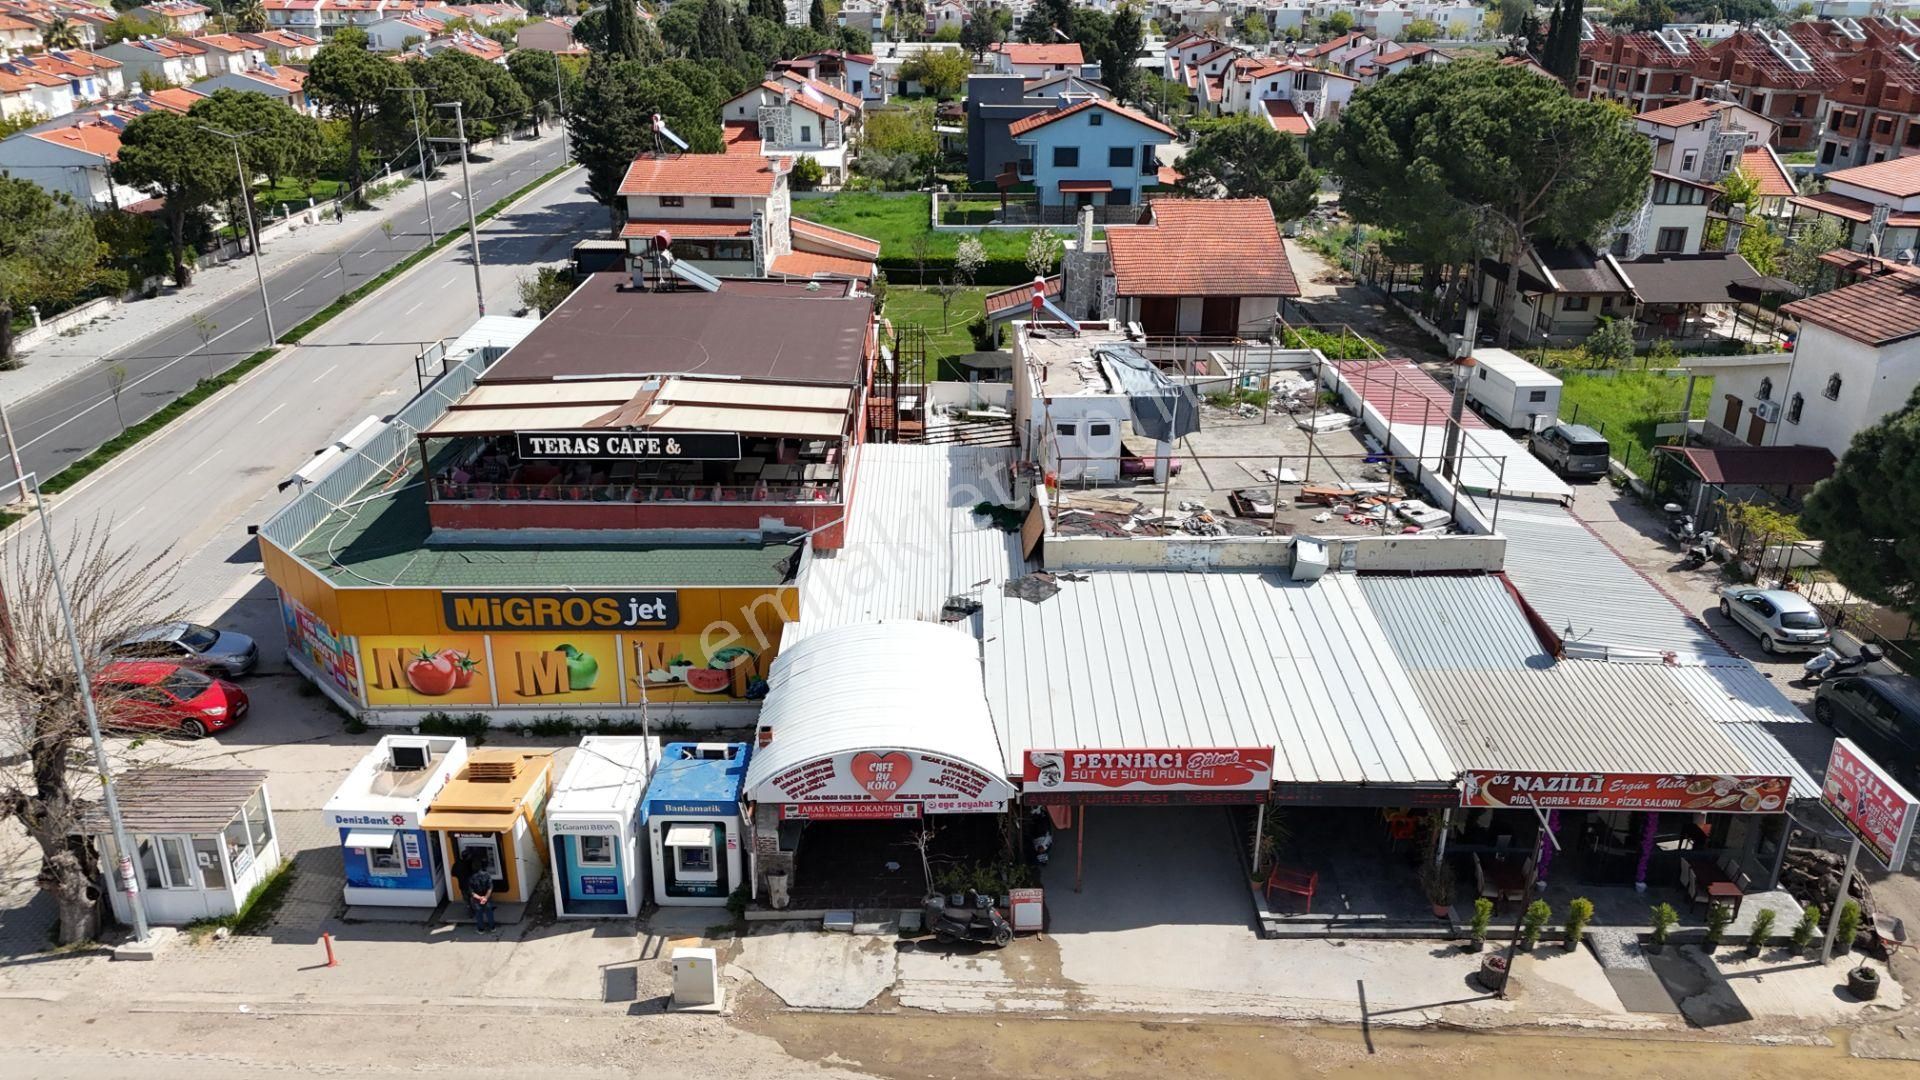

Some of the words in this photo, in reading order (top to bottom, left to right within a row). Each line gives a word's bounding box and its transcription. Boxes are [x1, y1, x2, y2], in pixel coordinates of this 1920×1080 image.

[529, 437, 599, 455] TERAS
[606, 437, 661, 455] CAFE
[665, 438, 682, 455] &
[623, 597, 667, 626] jet
[1187, 751, 1240, 770] Bülent
[869, 762, 894, 772] CAFE
[1071, 768, 1097, 780] SÜT
[1100, 769, 1117, 779] VE
[1120, 768, 1147, 779] SÜT
[1150, 767, 1215, 779] ÜRÜNLERİ
[866, 780, 897, 790] KOKO
[937, 801, 955, 810] ege
[957, 800, 993, 810] seyahat
[1539, 796, 1570, 806] ÇORBA
[1577, 796, 1609, 806] KEBAP
[1616, 795, 1642, 807] PİZZA
[1643, 798, 1682, 808] SALONU
[664, 804, 721, 813] Bankamatik
[825, 804, 854, 812] YEMEK
[855, 804, 901, 812] LOKANTASI
[335, 815, 390, 825] DenizBank
[562, 823, 590, 831] Garanti
